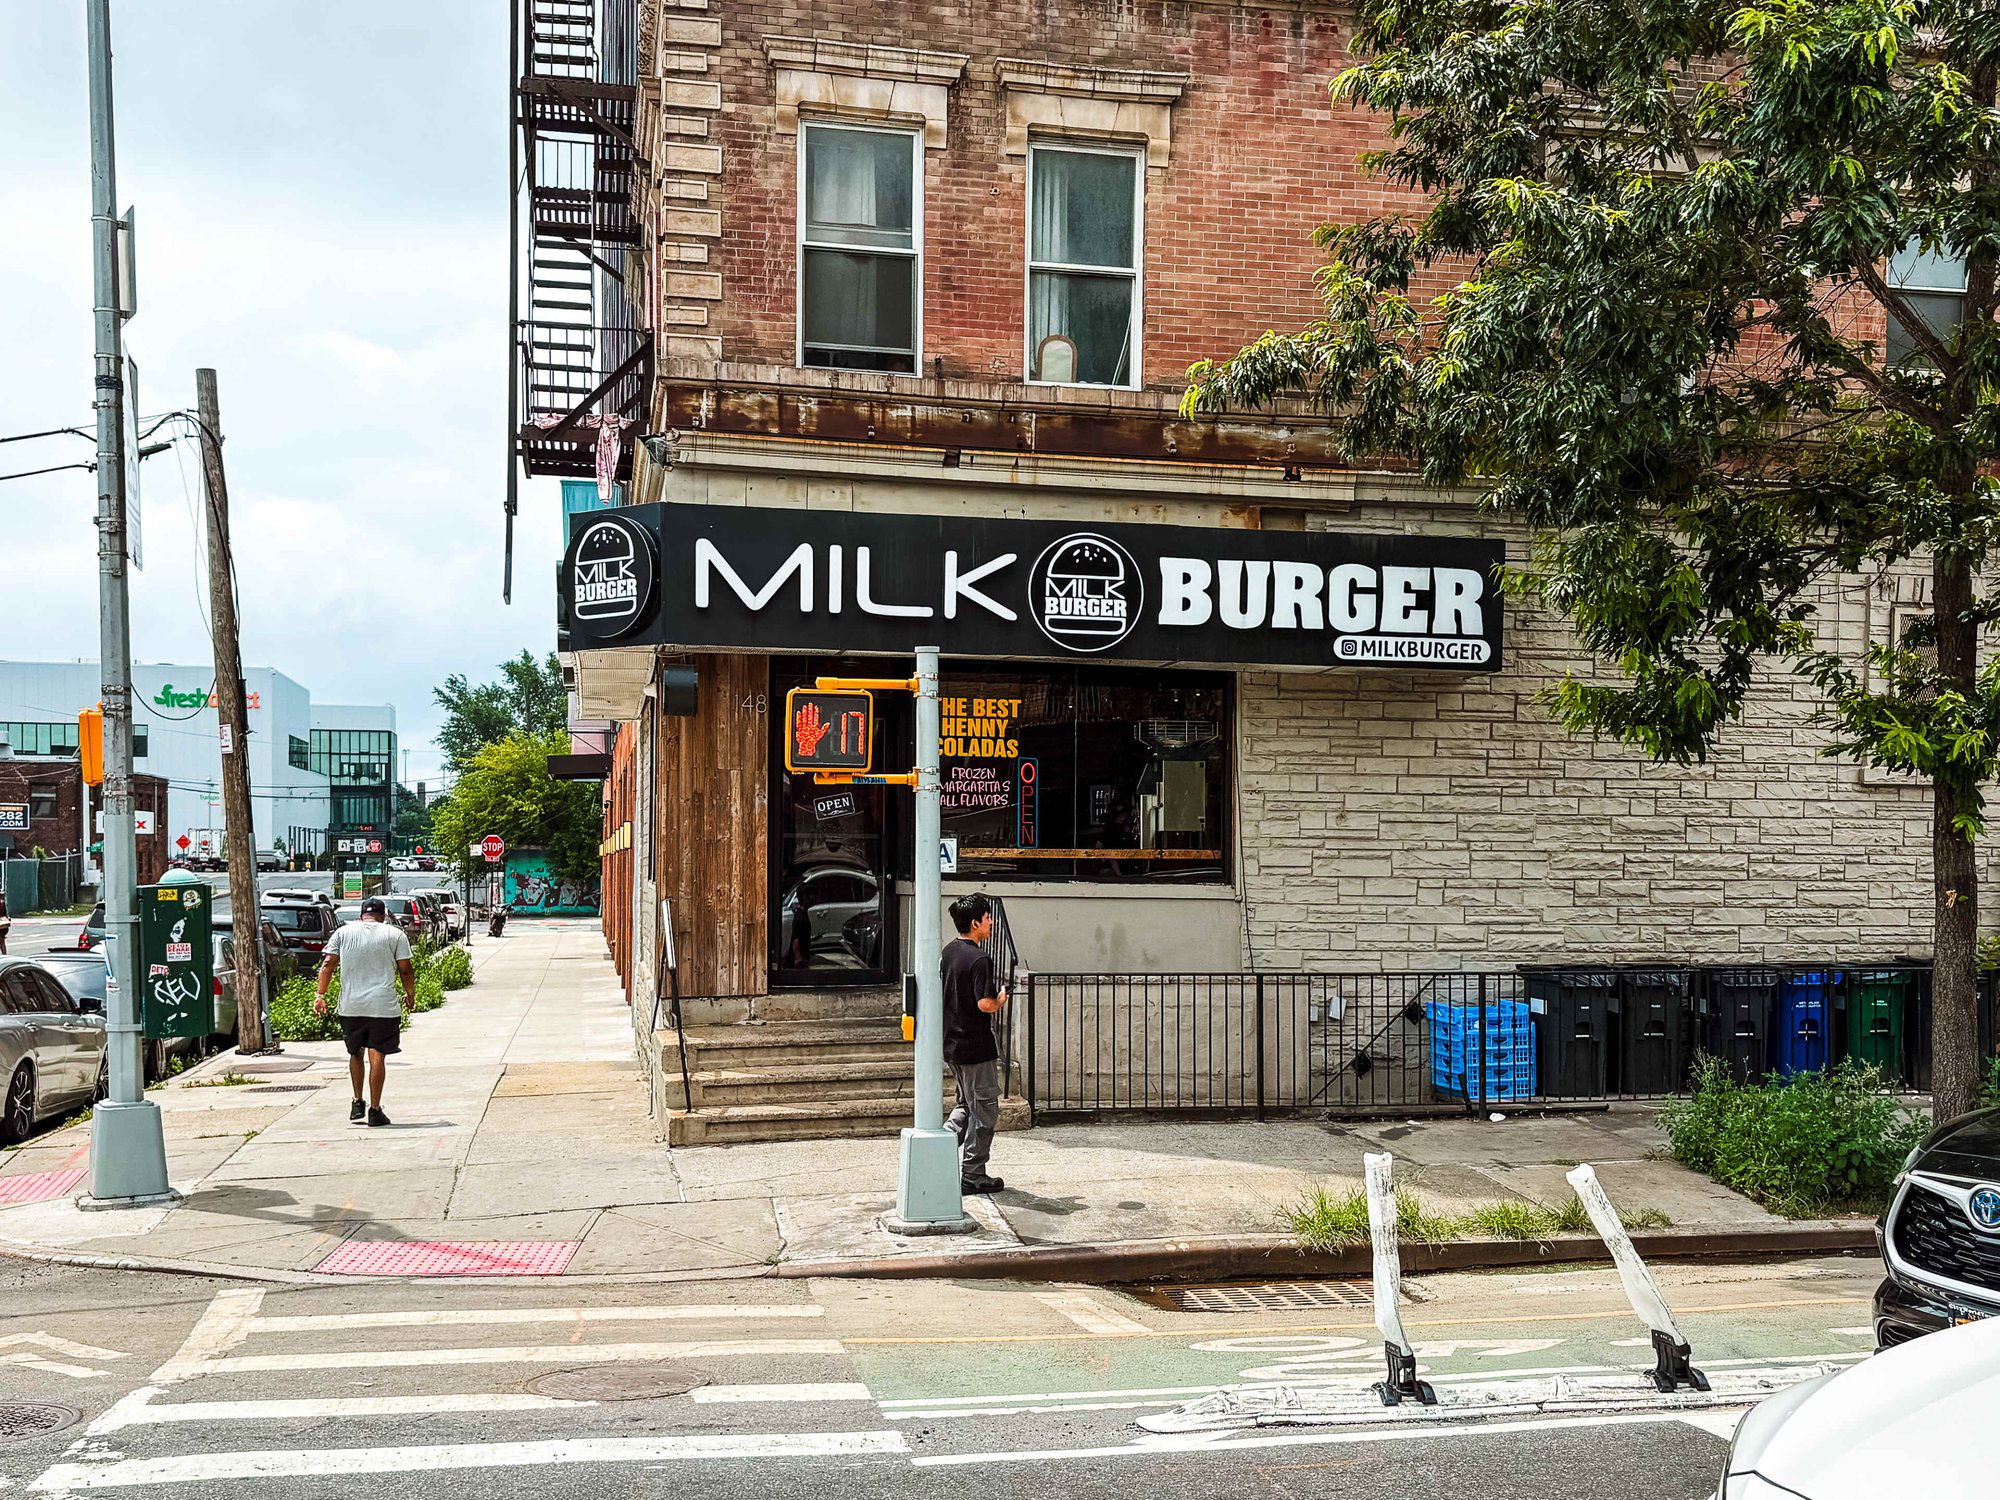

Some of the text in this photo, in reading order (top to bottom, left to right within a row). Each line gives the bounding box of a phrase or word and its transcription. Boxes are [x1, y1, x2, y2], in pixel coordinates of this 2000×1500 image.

[574, 558, 636, 585] MILK
[574, 578, 638, 603] BURGER
[695, 537, 1484, 636] MILK BURGER
[1045, 577, 1126, 600] MILK
[1044, 596, 1128, 618] BURGER
[1360, 639, 1483, 662] MILKBURGER
[154, 683, 260, 709] freshdct
[973, 698, 1022, 718] BEST
[942, 717, 1009, 738] HENNY
[951, 766, 996, 780] FROZEN
[817, 797, 850, 812] OPEN
[940, 793, 1009, 807] ALL FLAVORS
[1020, 762, 1036, 845] OPEN
[482, 842, 503, 852] STOP
